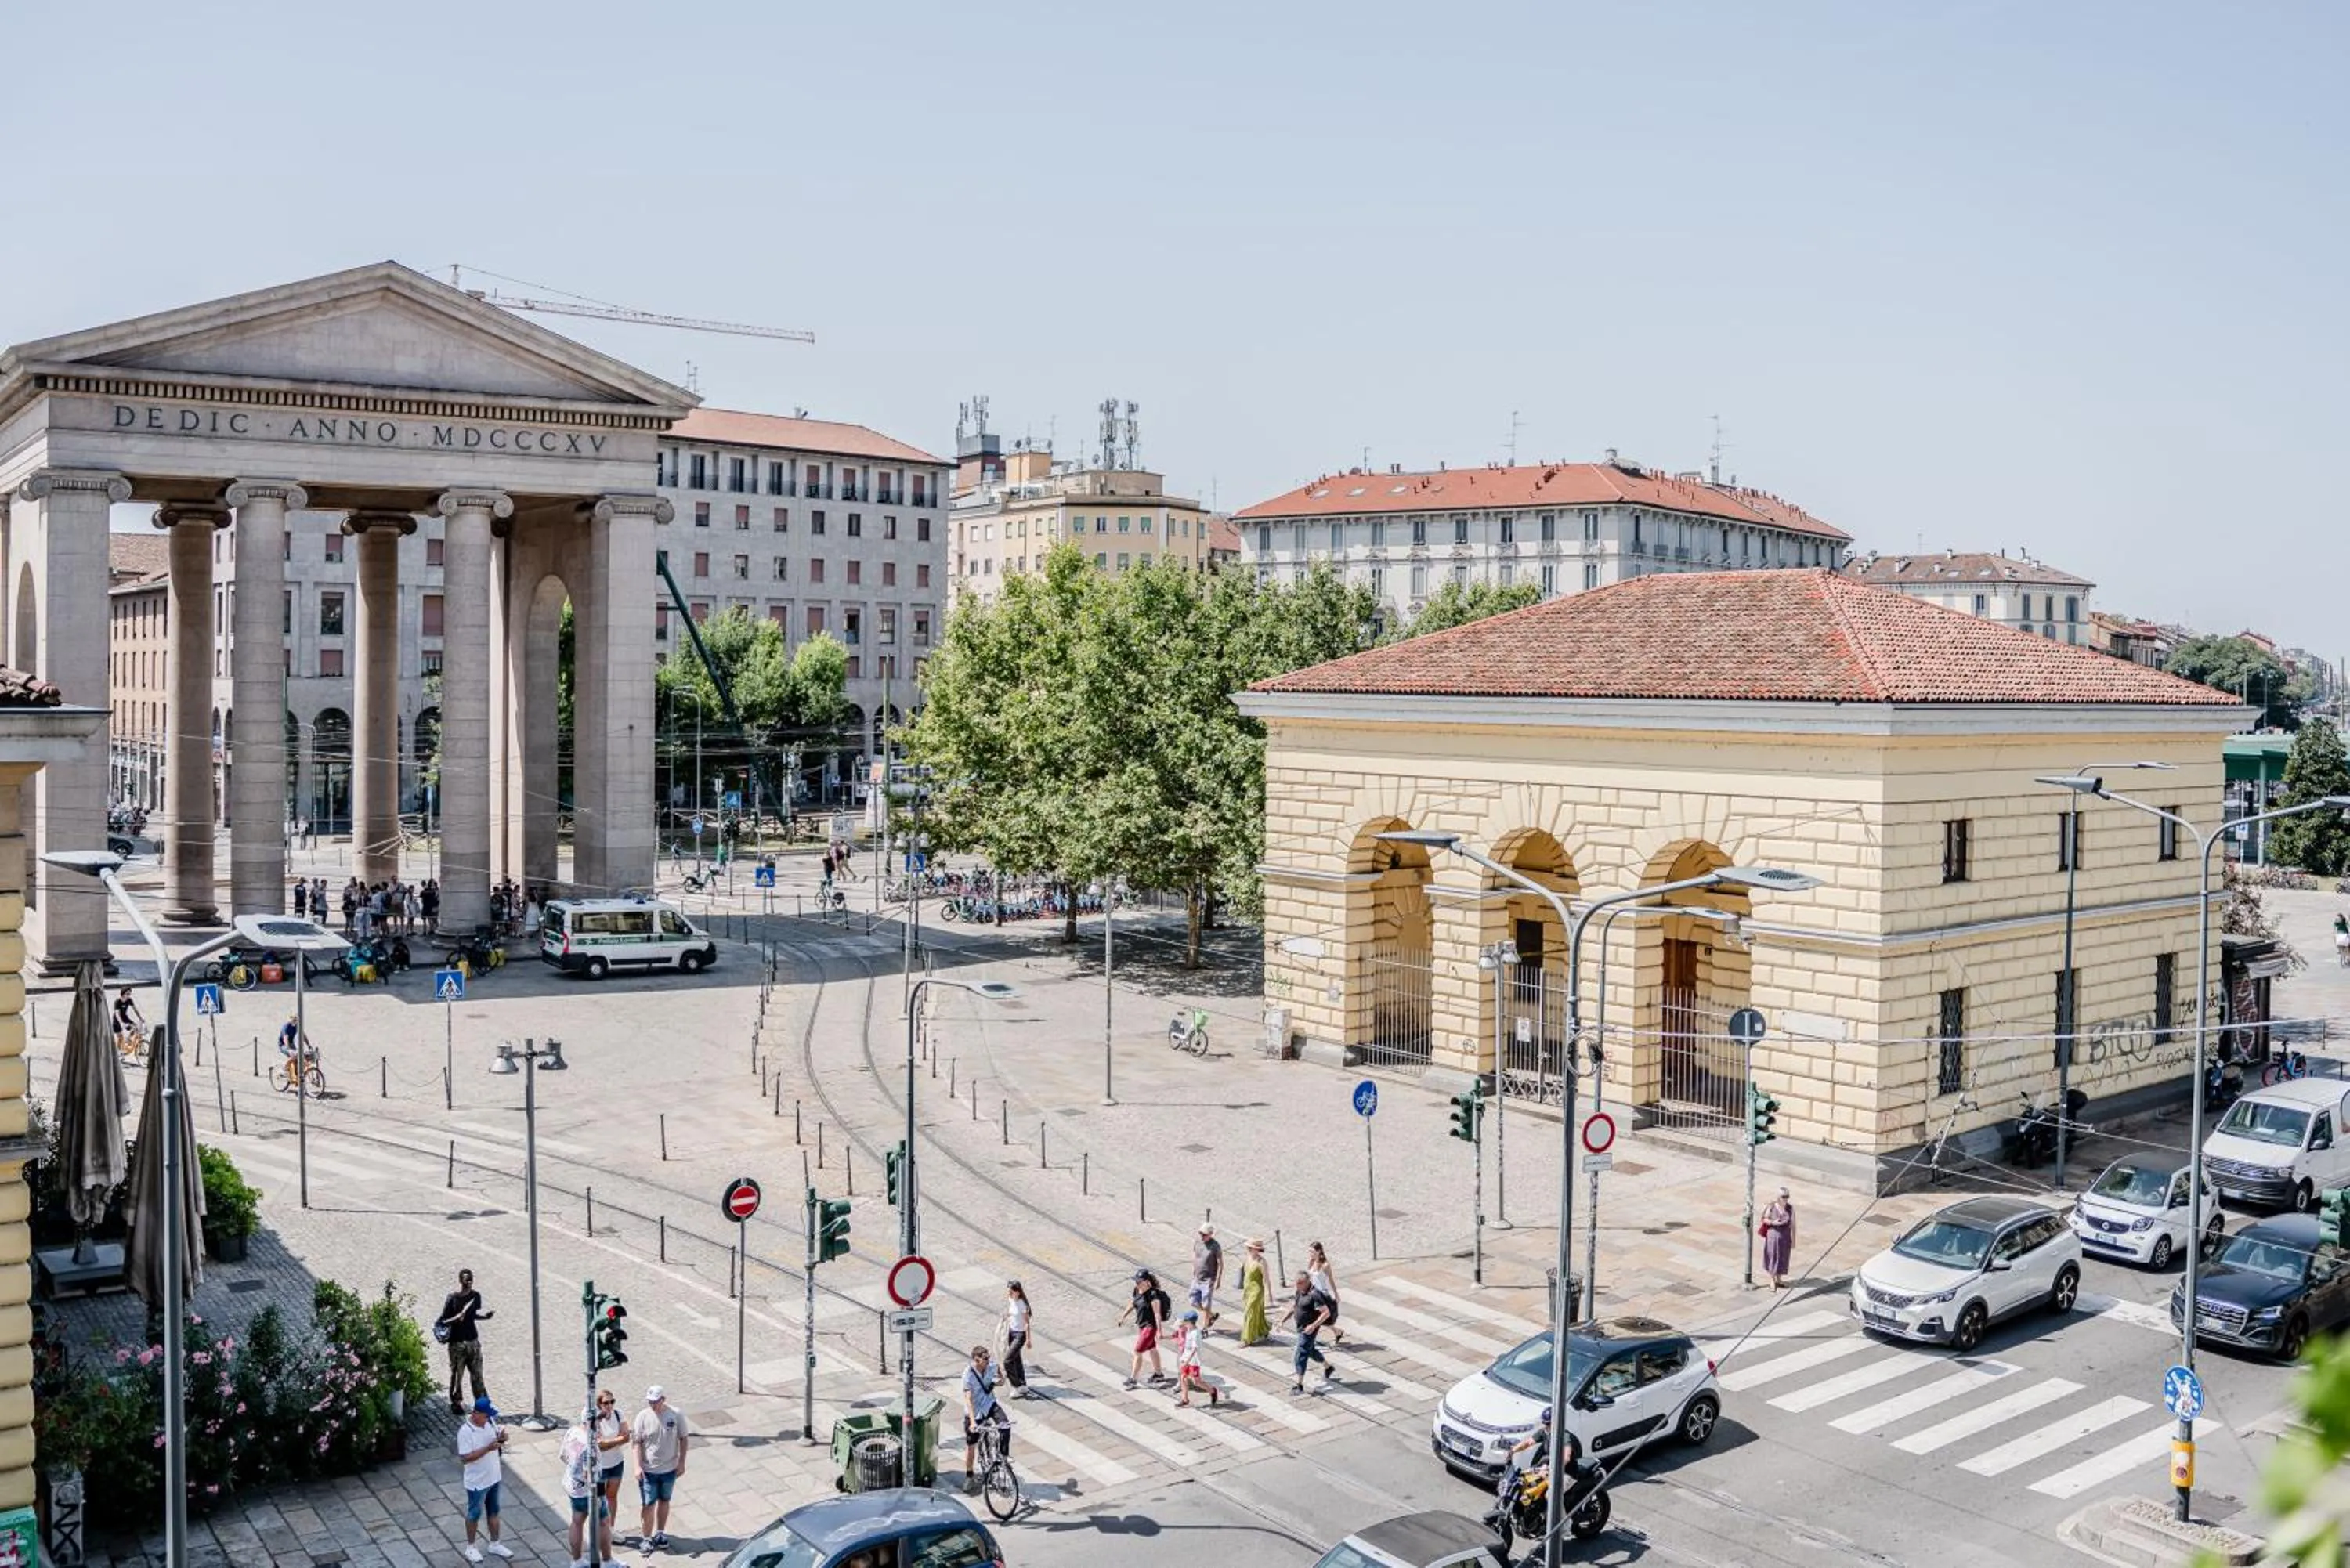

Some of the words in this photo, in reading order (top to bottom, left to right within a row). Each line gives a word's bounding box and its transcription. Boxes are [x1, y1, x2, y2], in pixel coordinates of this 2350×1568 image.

[114, 406, 250, 434] DEDIC
[289, 418, 396, 441] ANNO
[433, 425, 607, 453] MDCCCXV
